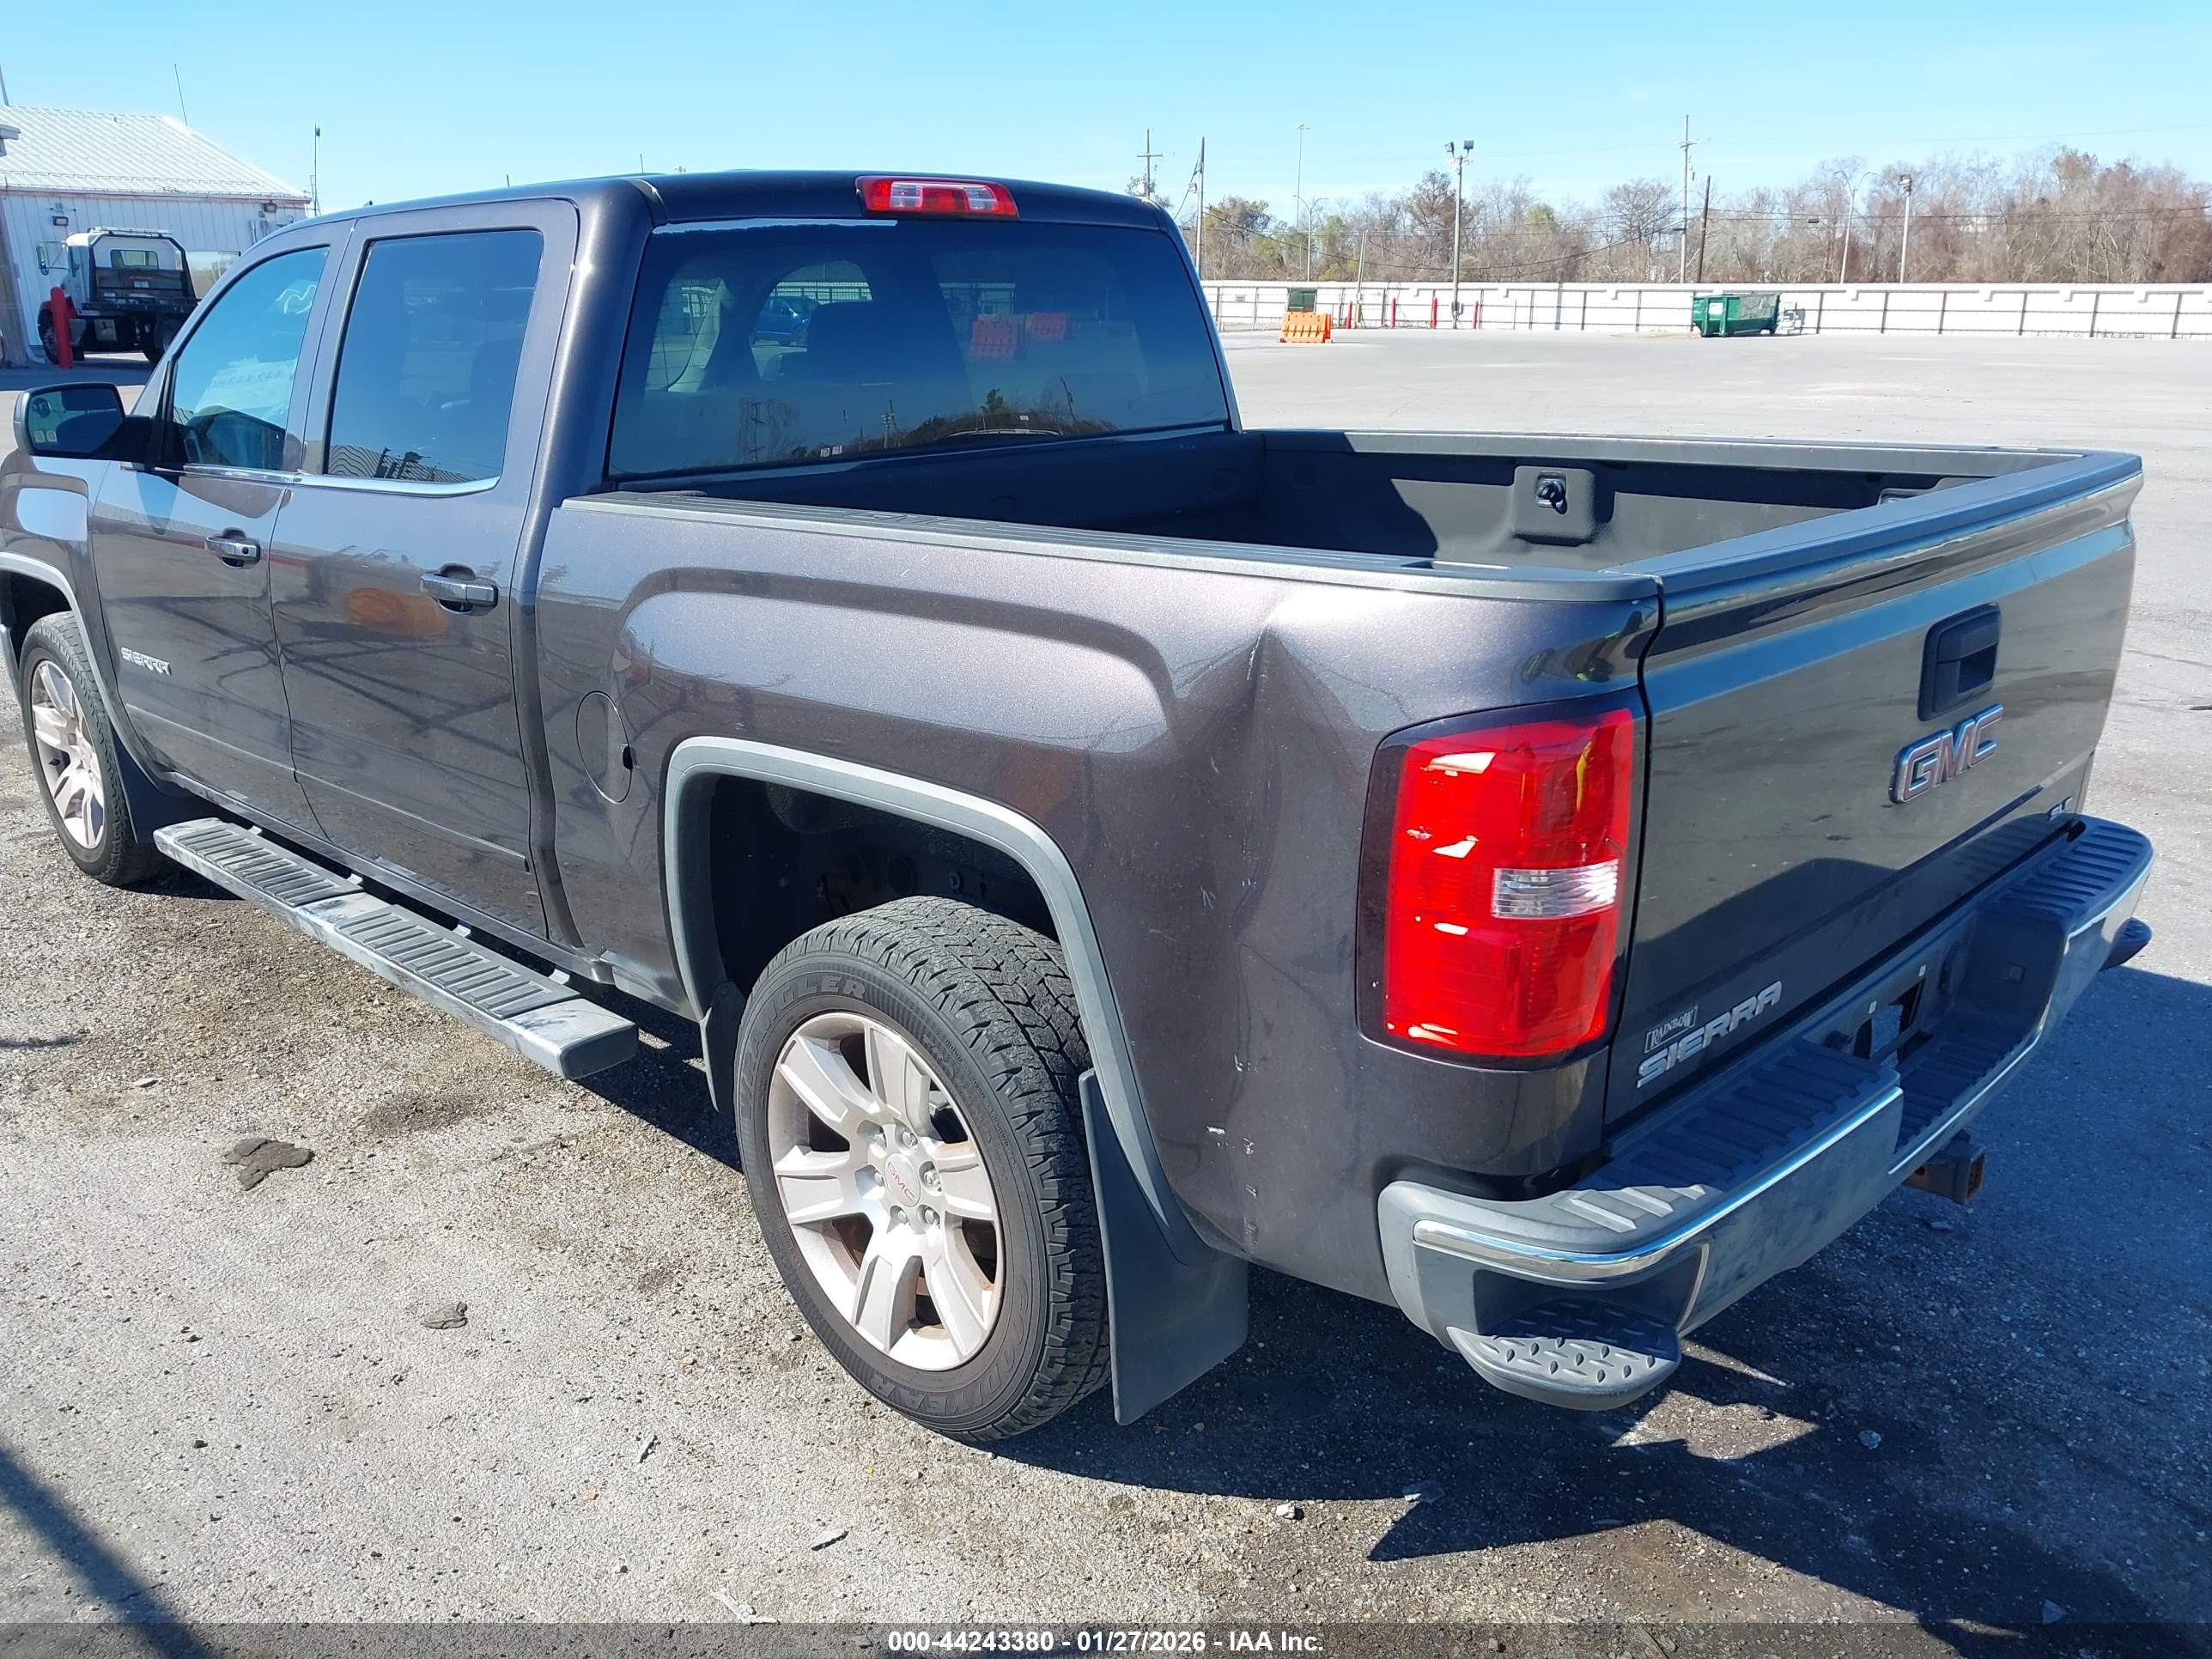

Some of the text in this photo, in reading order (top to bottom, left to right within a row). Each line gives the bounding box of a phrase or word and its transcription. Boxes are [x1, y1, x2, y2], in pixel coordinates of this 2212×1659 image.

[120, 646, 172, 677] SIERRA
[1889, 703, 2004, 804] GMC
[1637, 981, 1783, 1088] SIERRA
[887, 1160, 916, 1203] GMC
